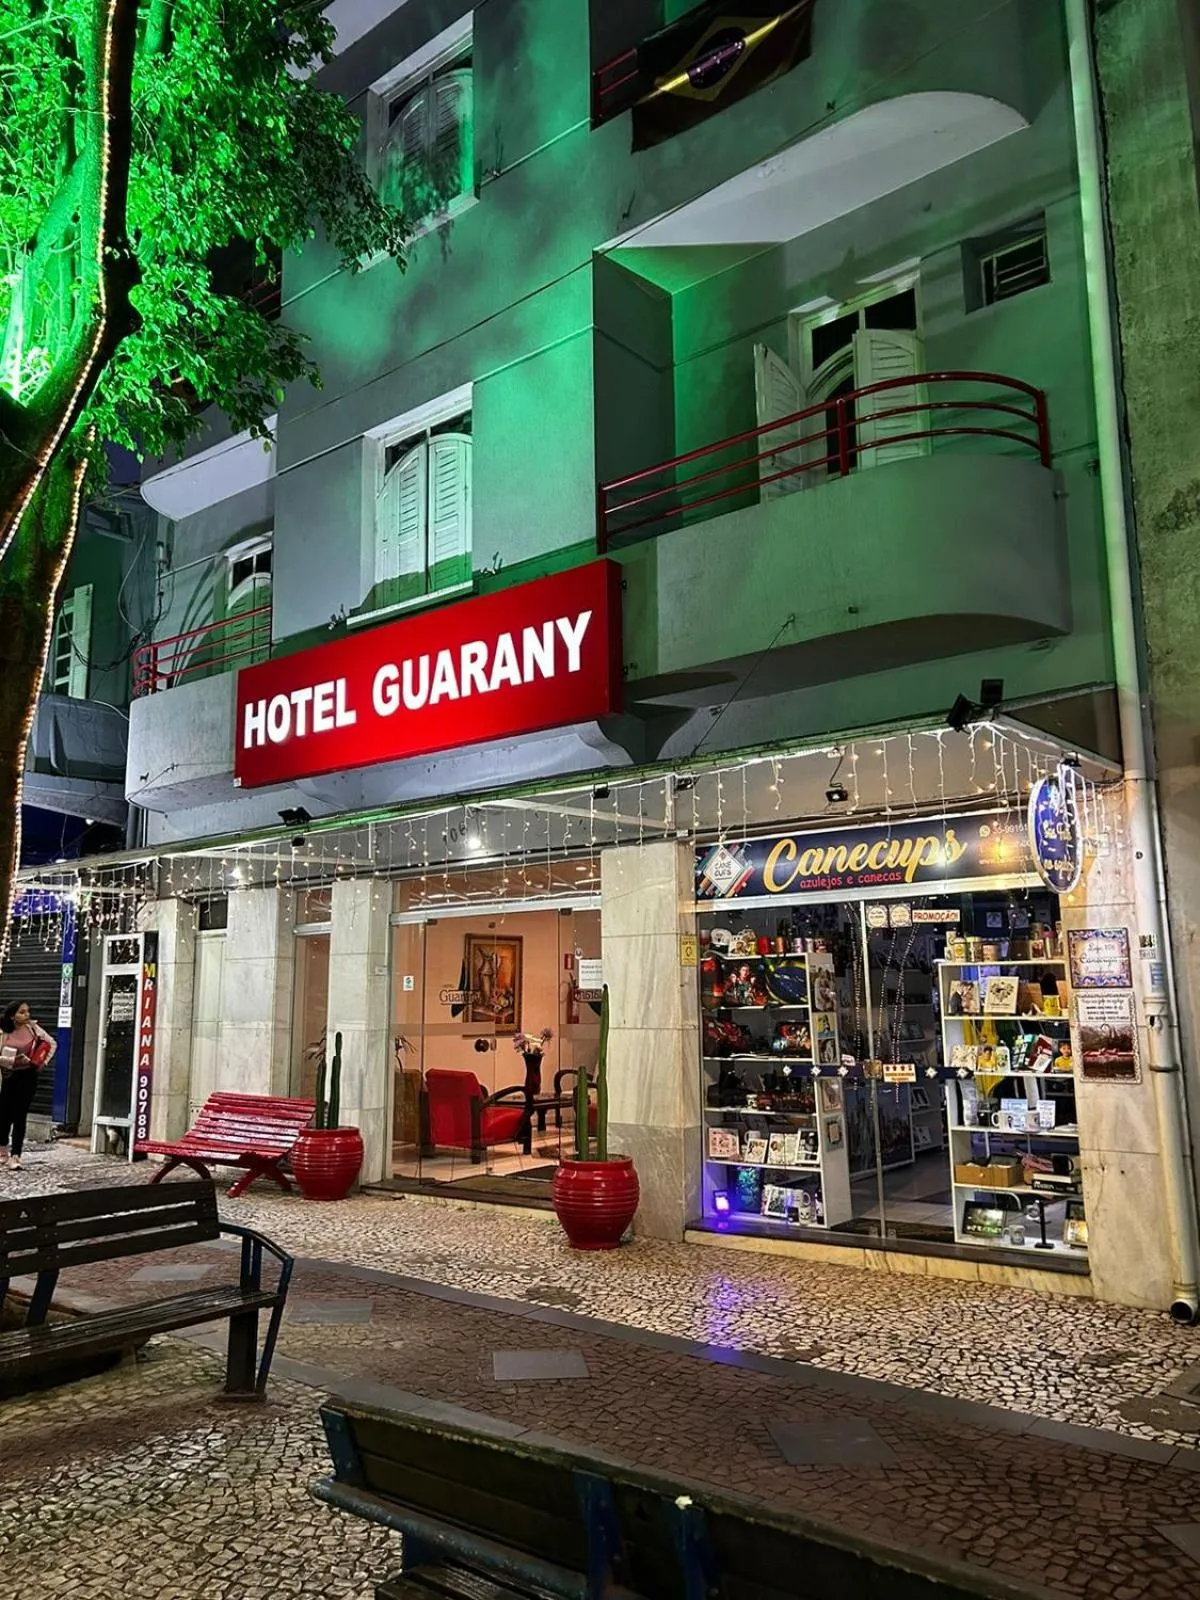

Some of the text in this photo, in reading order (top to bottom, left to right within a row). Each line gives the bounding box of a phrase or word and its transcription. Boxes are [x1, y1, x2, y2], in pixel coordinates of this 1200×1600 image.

[243, 610, 593, 748] HOTEL GUARANY
[763, 829, 968, 893] Canecups
[799, 872, 902, 890] azulejos e canecas
[137, 1076, 148, 1139] 90788
